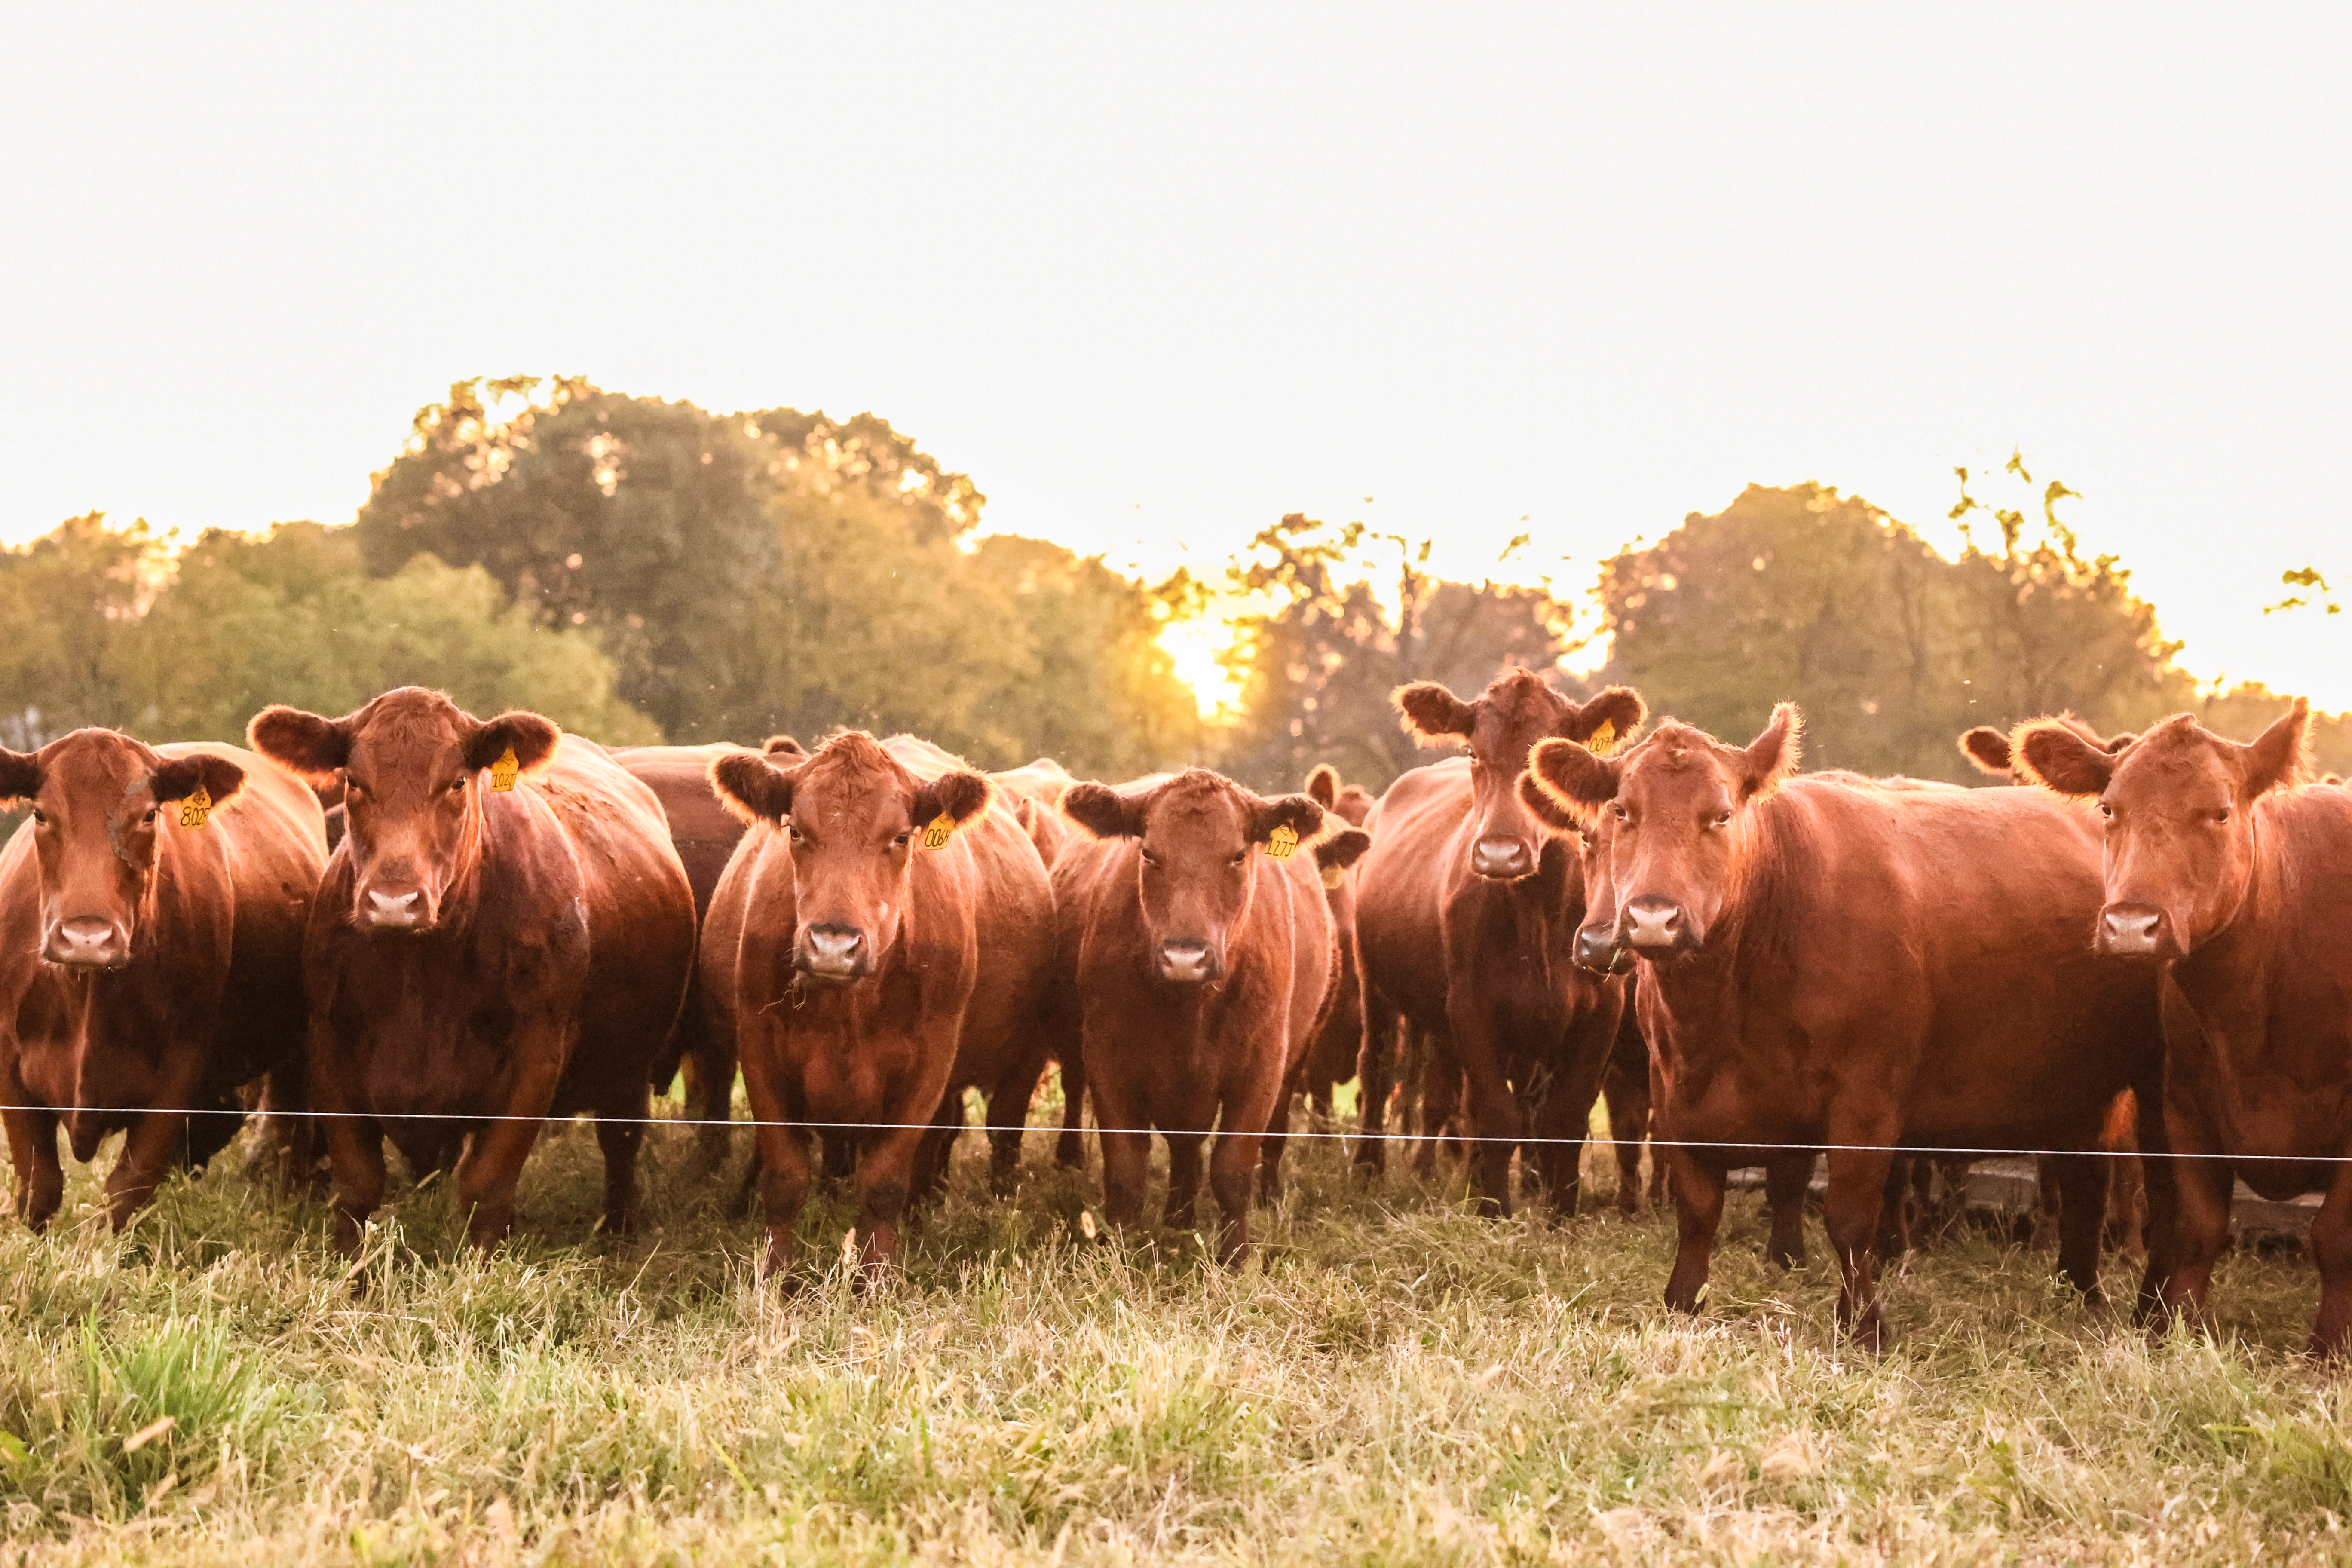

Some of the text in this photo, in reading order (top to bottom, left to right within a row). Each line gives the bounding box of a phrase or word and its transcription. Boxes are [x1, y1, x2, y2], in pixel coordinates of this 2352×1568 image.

[492, 773, 515, 790] 102J
[925, 827, 951, 847] 006H
[1265, 840, 1295, 857] 127J
